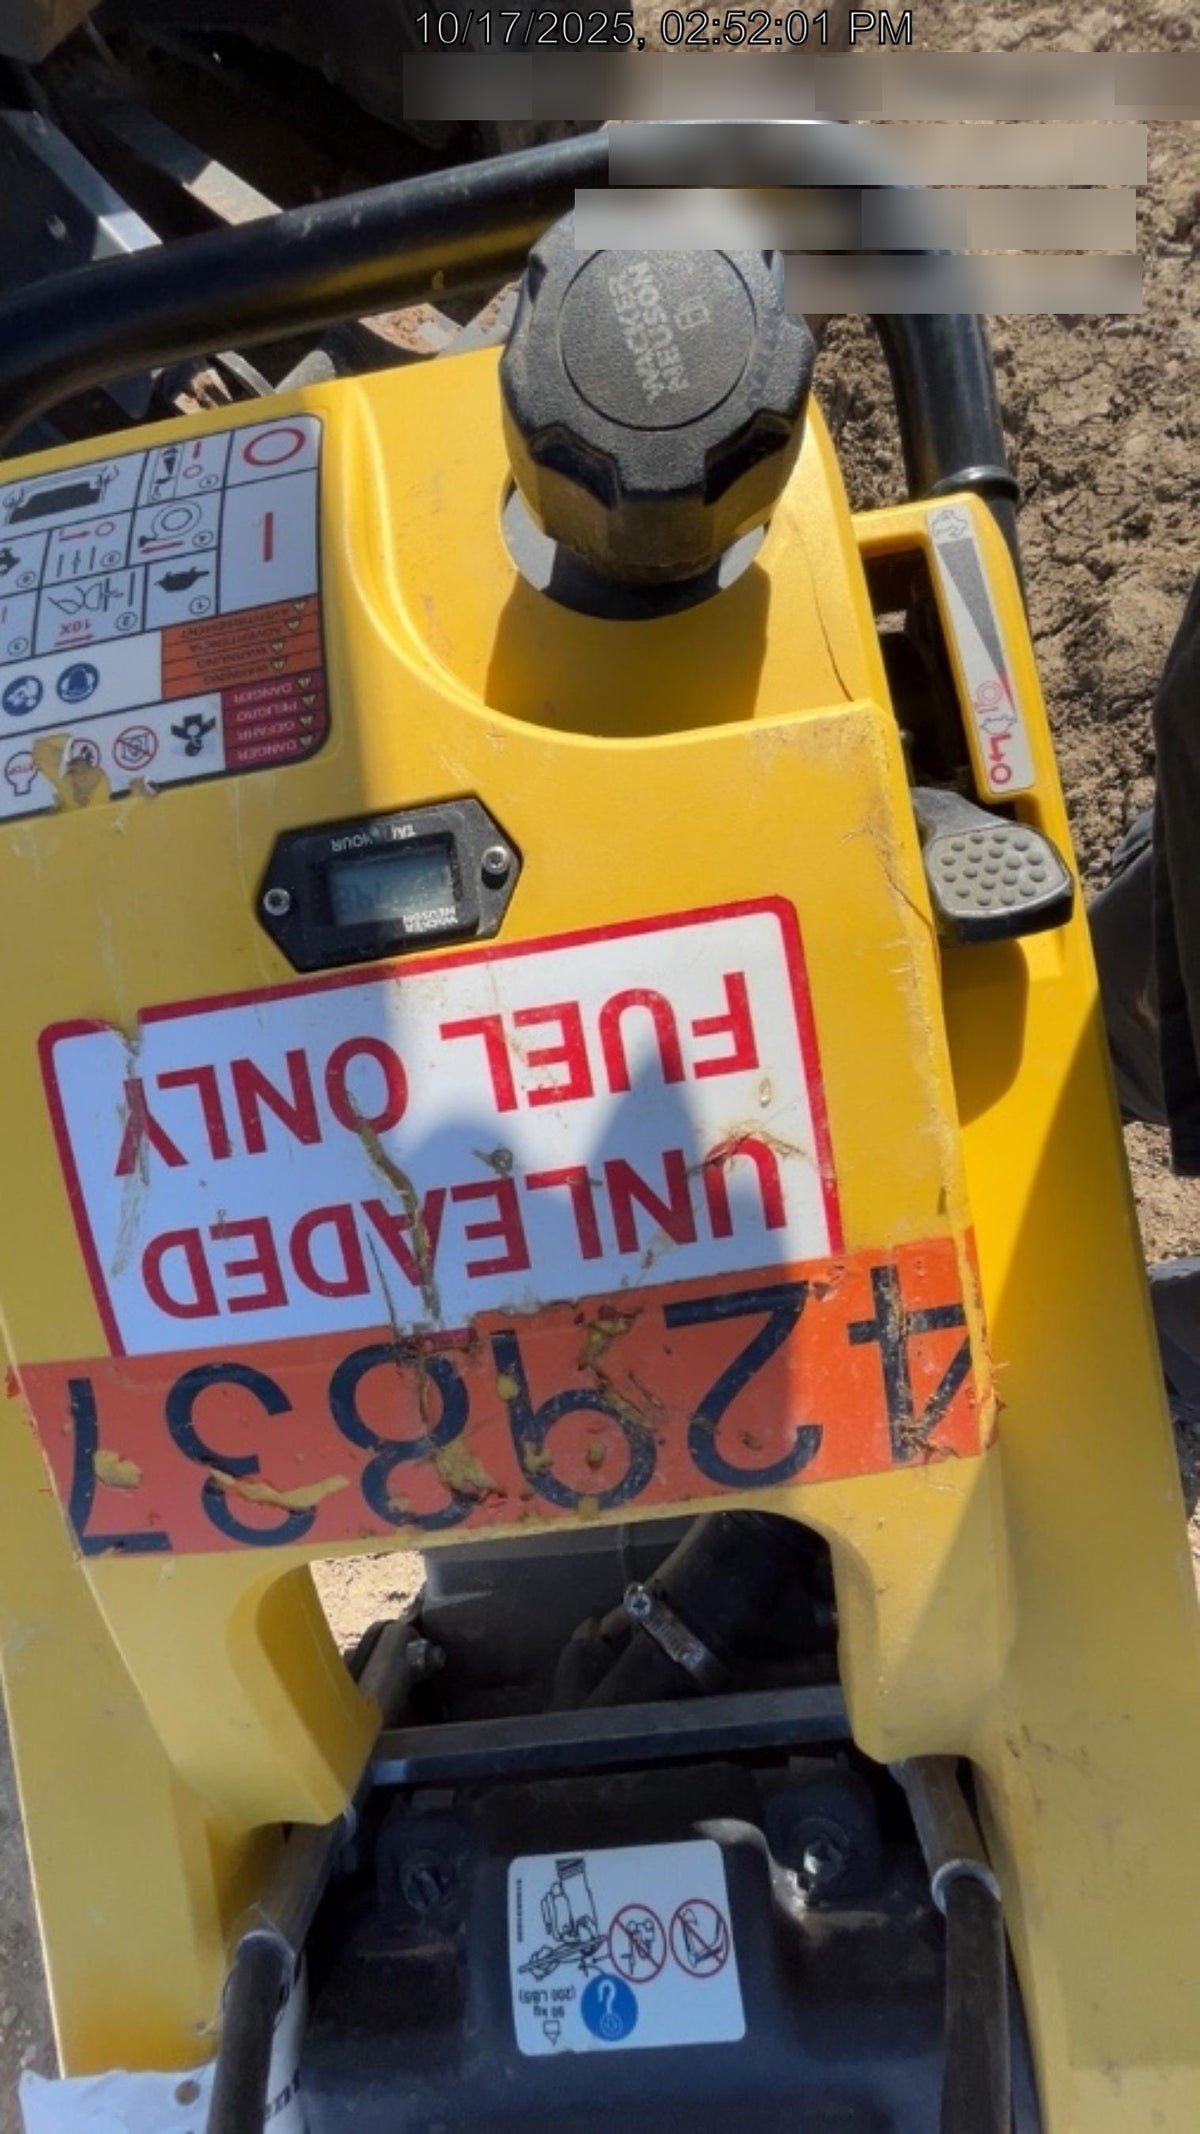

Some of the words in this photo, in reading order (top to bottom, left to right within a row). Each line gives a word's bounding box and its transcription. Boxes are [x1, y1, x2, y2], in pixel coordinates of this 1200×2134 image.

[608, 272, 664, 403] WACKER
[621, 261, 690, 394] NEUSON
[60, 619, 91, 635] 10X
[234, 682, 293, 703] DANGER
[236, 700, 298, 721] PELIGRO
[237, 720, 295, 741] GEFAHR
[238, 739, 297, 760] DANGER
[439, 971, 762, 1113] FUEL
[114, 1036, 409, 1176] ONLY
[142, 1135, 787, 1319] UNLEADED
[66, 1265, 970, 1557] 429837
[533, 2005, 548, 2018] kg
